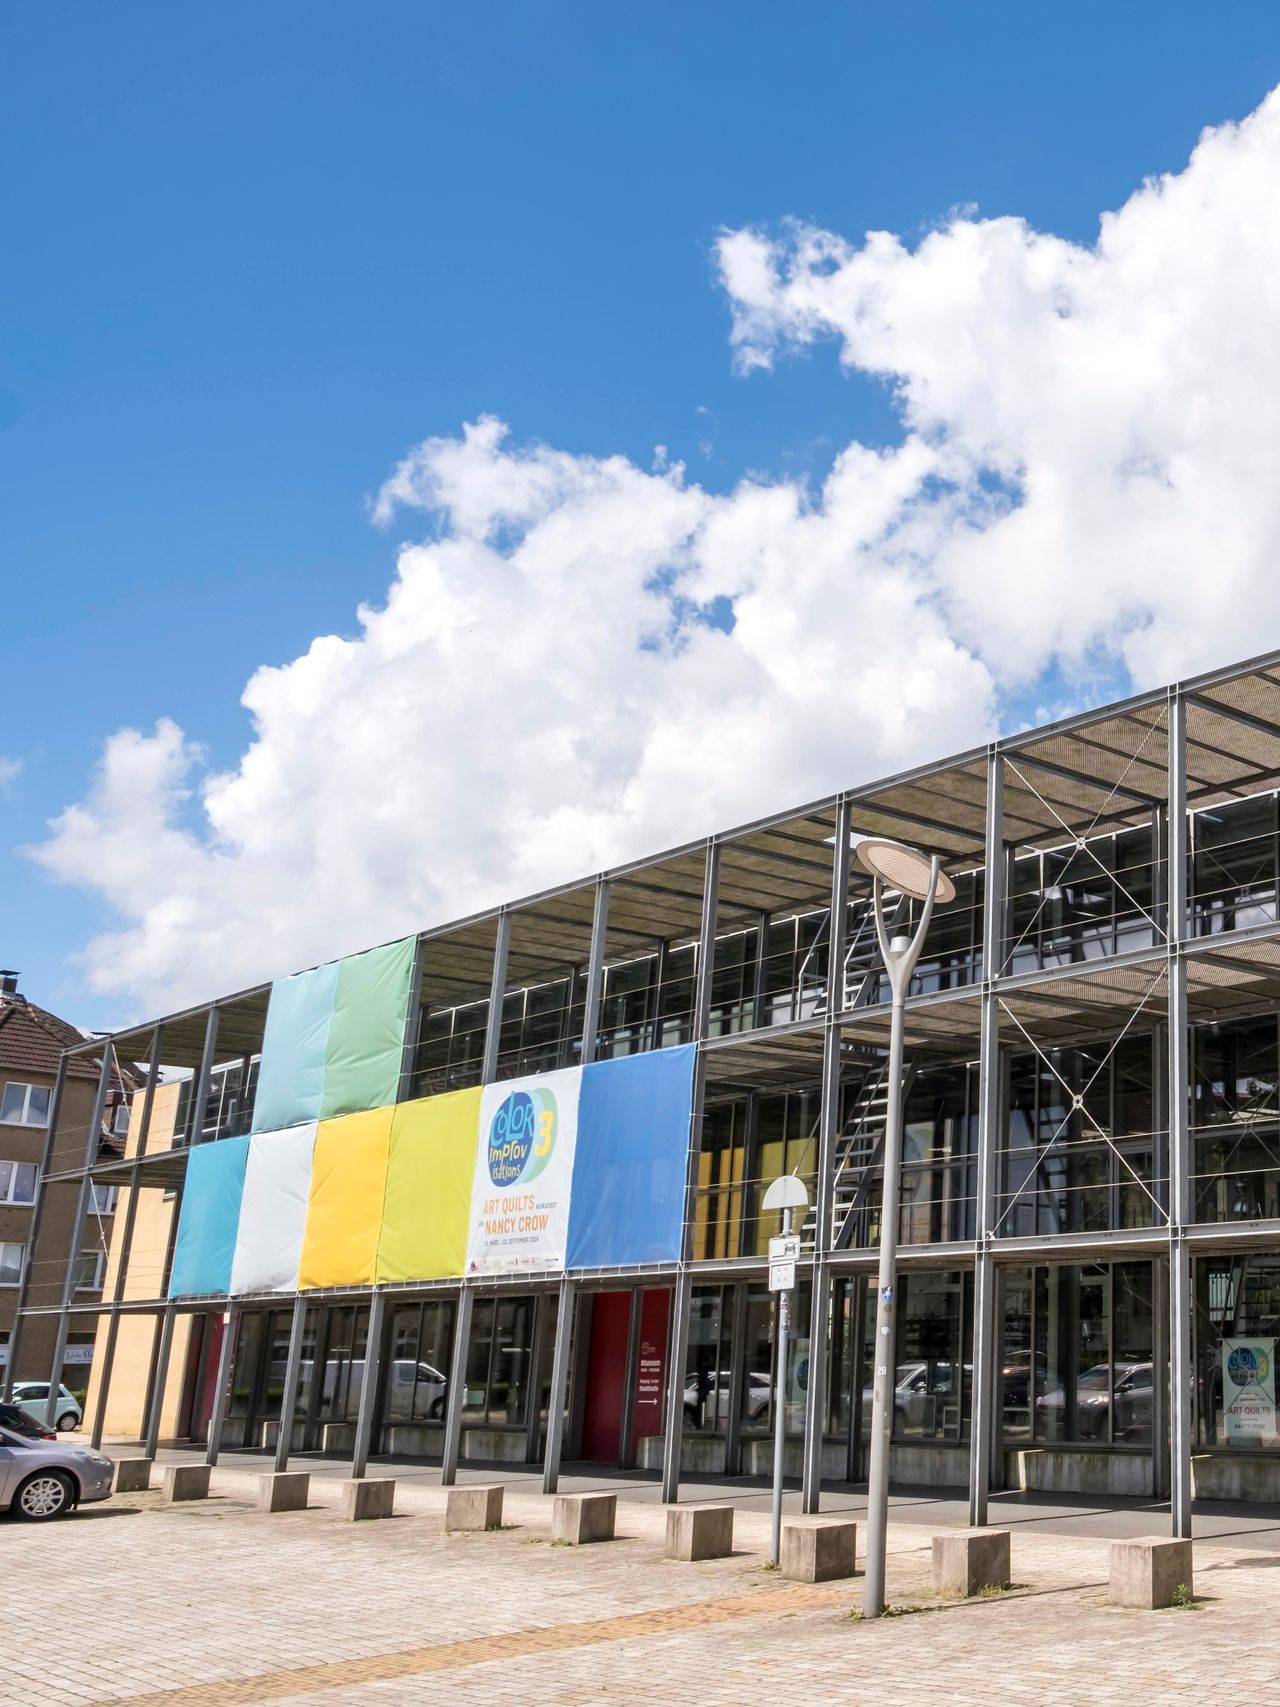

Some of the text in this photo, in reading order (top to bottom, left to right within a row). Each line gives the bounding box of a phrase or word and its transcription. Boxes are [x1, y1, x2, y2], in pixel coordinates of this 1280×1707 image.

[535, 1110, 554, 1156] 3
[483, 1199, 500, 1215] ART
[503, 1194, 535, 1216] QUILTS
[485, 1214, 549, 1236] NANCY CROW
[1228, 1406, 1271, 1415] ART QUILTS
